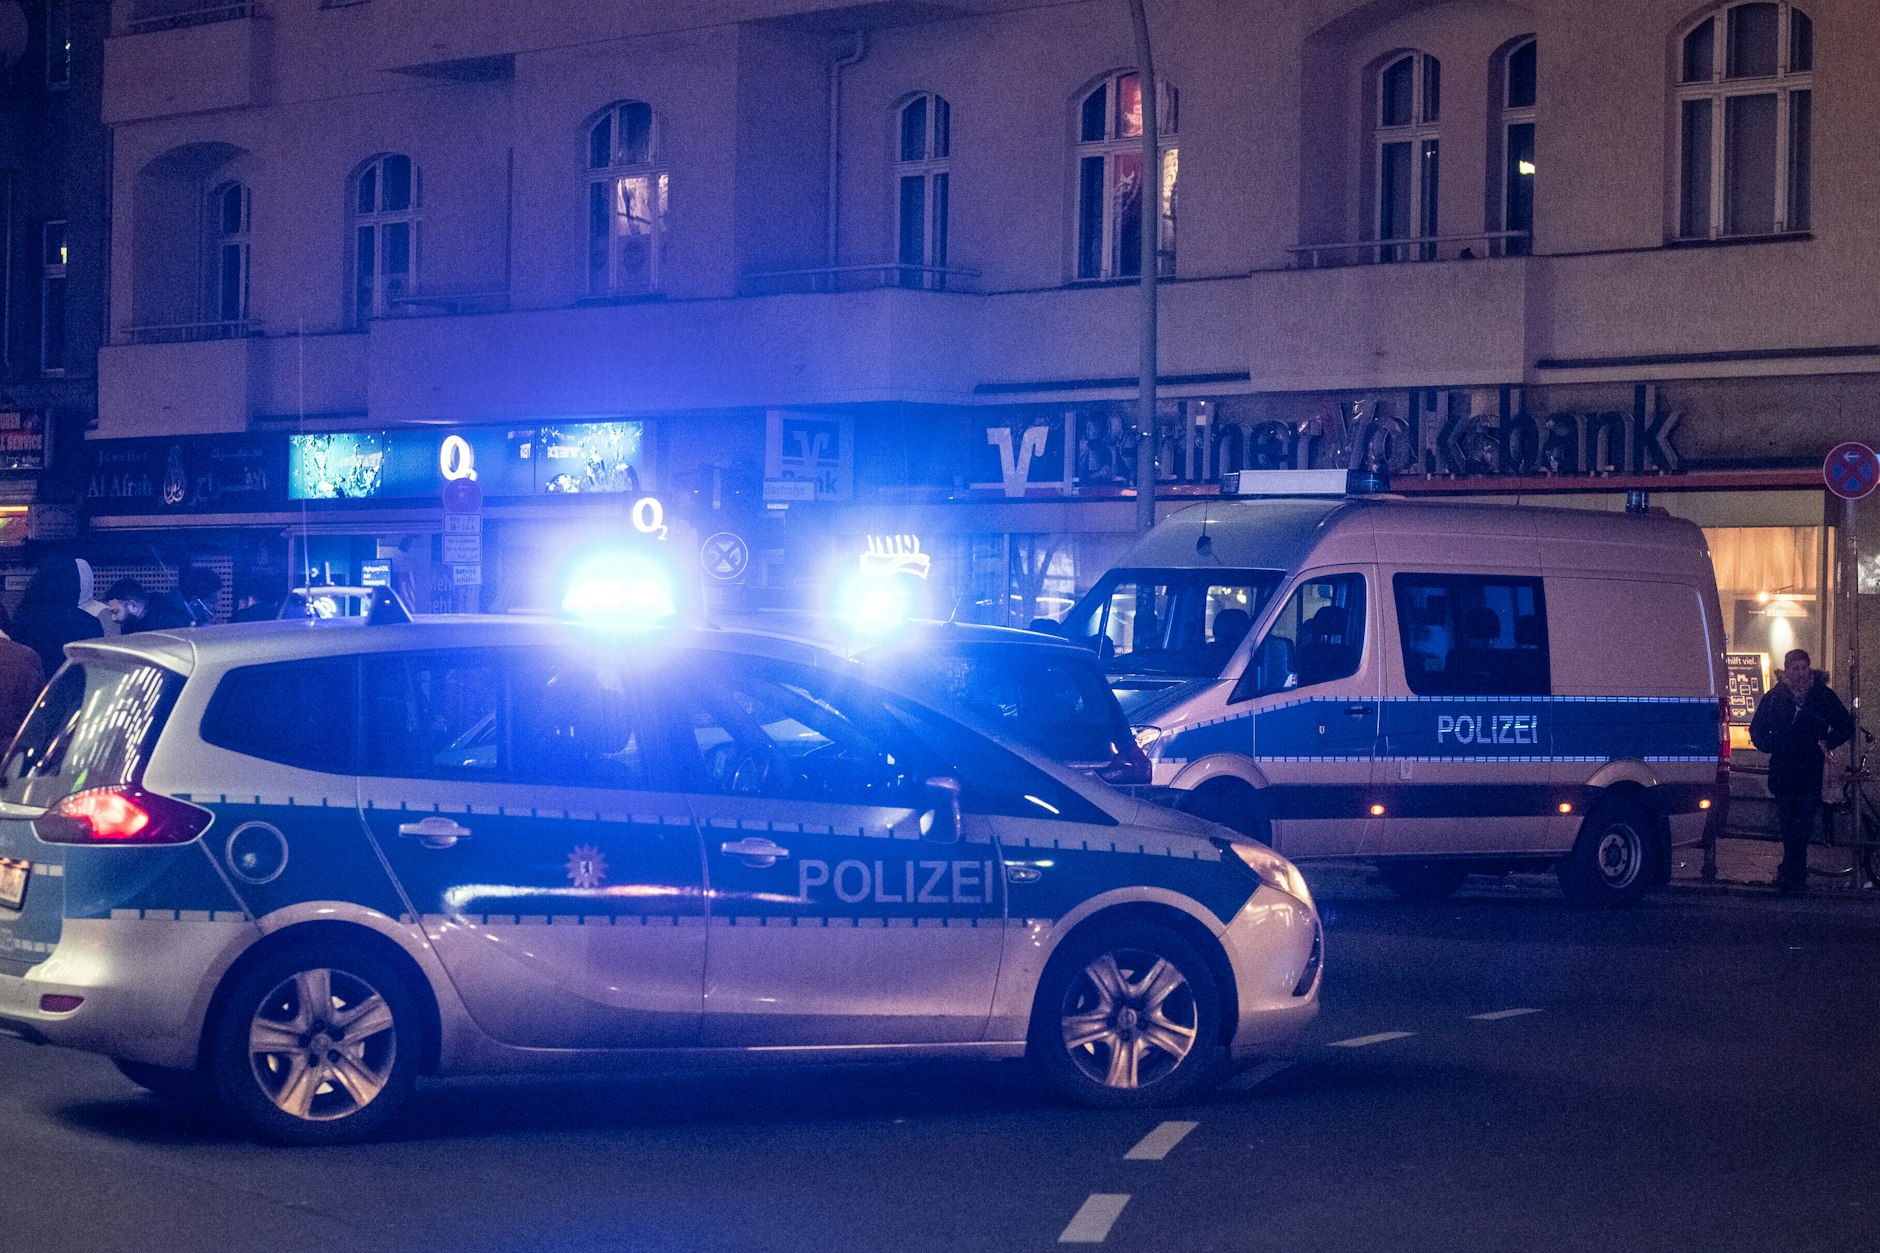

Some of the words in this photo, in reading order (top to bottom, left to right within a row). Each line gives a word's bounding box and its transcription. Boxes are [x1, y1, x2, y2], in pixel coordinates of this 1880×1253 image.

[87, 473, 106, 498] Al
[1727, 656, 1742, 665] hilft
[1438, 715, 1538, 744] POLIZEI
[800, 859, 994, 904] POLIZEI
